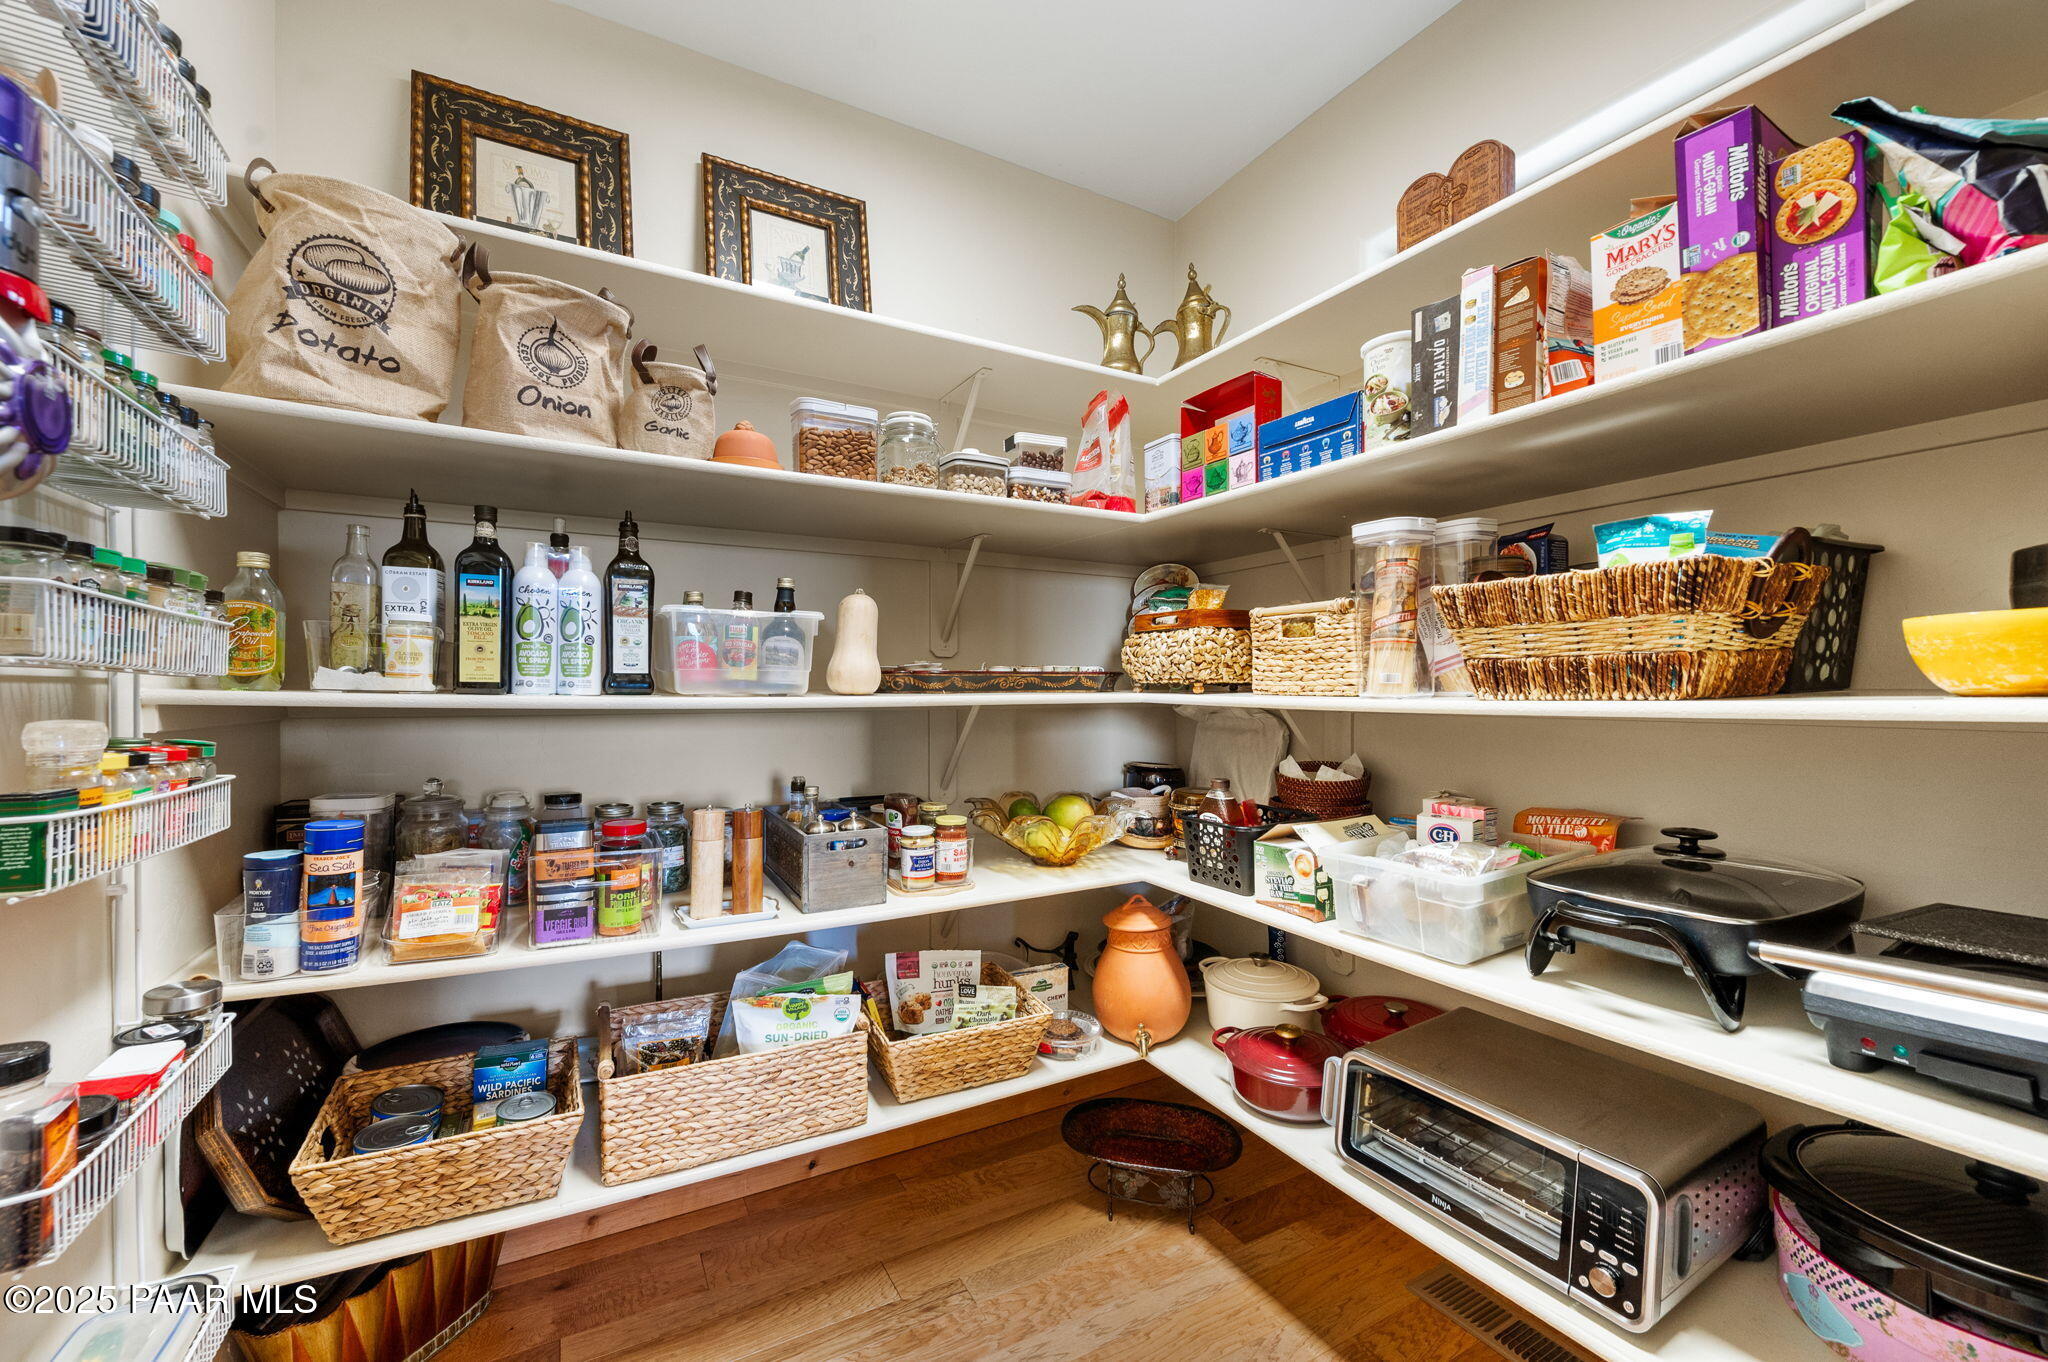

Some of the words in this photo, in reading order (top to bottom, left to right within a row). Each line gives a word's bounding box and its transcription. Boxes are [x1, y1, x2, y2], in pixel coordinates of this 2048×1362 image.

[1727, 142, 1748, 202] Milton's
[1702, 150, 1718, 216] MULTI-GRAIN
[1620, 215, 1657, 237] Organic
[1606, 223, 1676, 269] MARY'S
[1606, 263, 1628, 277] GONE
[1630, 241, 1673, 267] CRACKERS
[1804, 255, 1820, 313] ORIGINAL
[1820, 244, 1837, 312] MULTI-GRAIN
[1779, 262, 1800, 318] Milton's
[299, 282, 382, 320] ORGANIC
[312, 300, 337, 318] FARM
[340, 314, 368, 323] FRESH
[268, 309, 401, 373] Potato
[521, 343, 552, 382] ECOLOGY
[561, 355, 586, 386] PRODUCT
[1431, 339, 1446, 394] OATMEAL
[517, 385, 591, 418] Onion
[644, 421, 690, 440] Garlic
[518, 585, 551, 594] Chosen
[384, 604, 416, 612] EXTRA
[242, 636, 259, 645] Oil
[1526, 815, 1567, 826] MONK
[1566, 816, 1609, 826] FRUIT
[1531, 824, 1546, 835] IN
[1547, 824, 1574, 835] THE
[1432, 829, 1459, 843] C&H
[309, 862, 330, 873] Sea
[331, 860, 355, 871] Salt
[1265, 875, 1289, 885] STEVIA
[610, 892, 636, 900] PORK
[544, 918, 573, 932] VEGGIE
[933, 968, 972, 980] heavenly
[1047, 993, 1067, 1001] CHEWY
[776, 1021, 818, 1031] ORGANIC
[765, 1030, 828, 1043] SUN-DRIED
[477, 1083, 502, 1093] WILD
[505, 1076, 541, 1090] PACIFIC
[485, 1086, 533, 1101] SARDINES
[1431, 1193, 1452, 1212] NINJA
